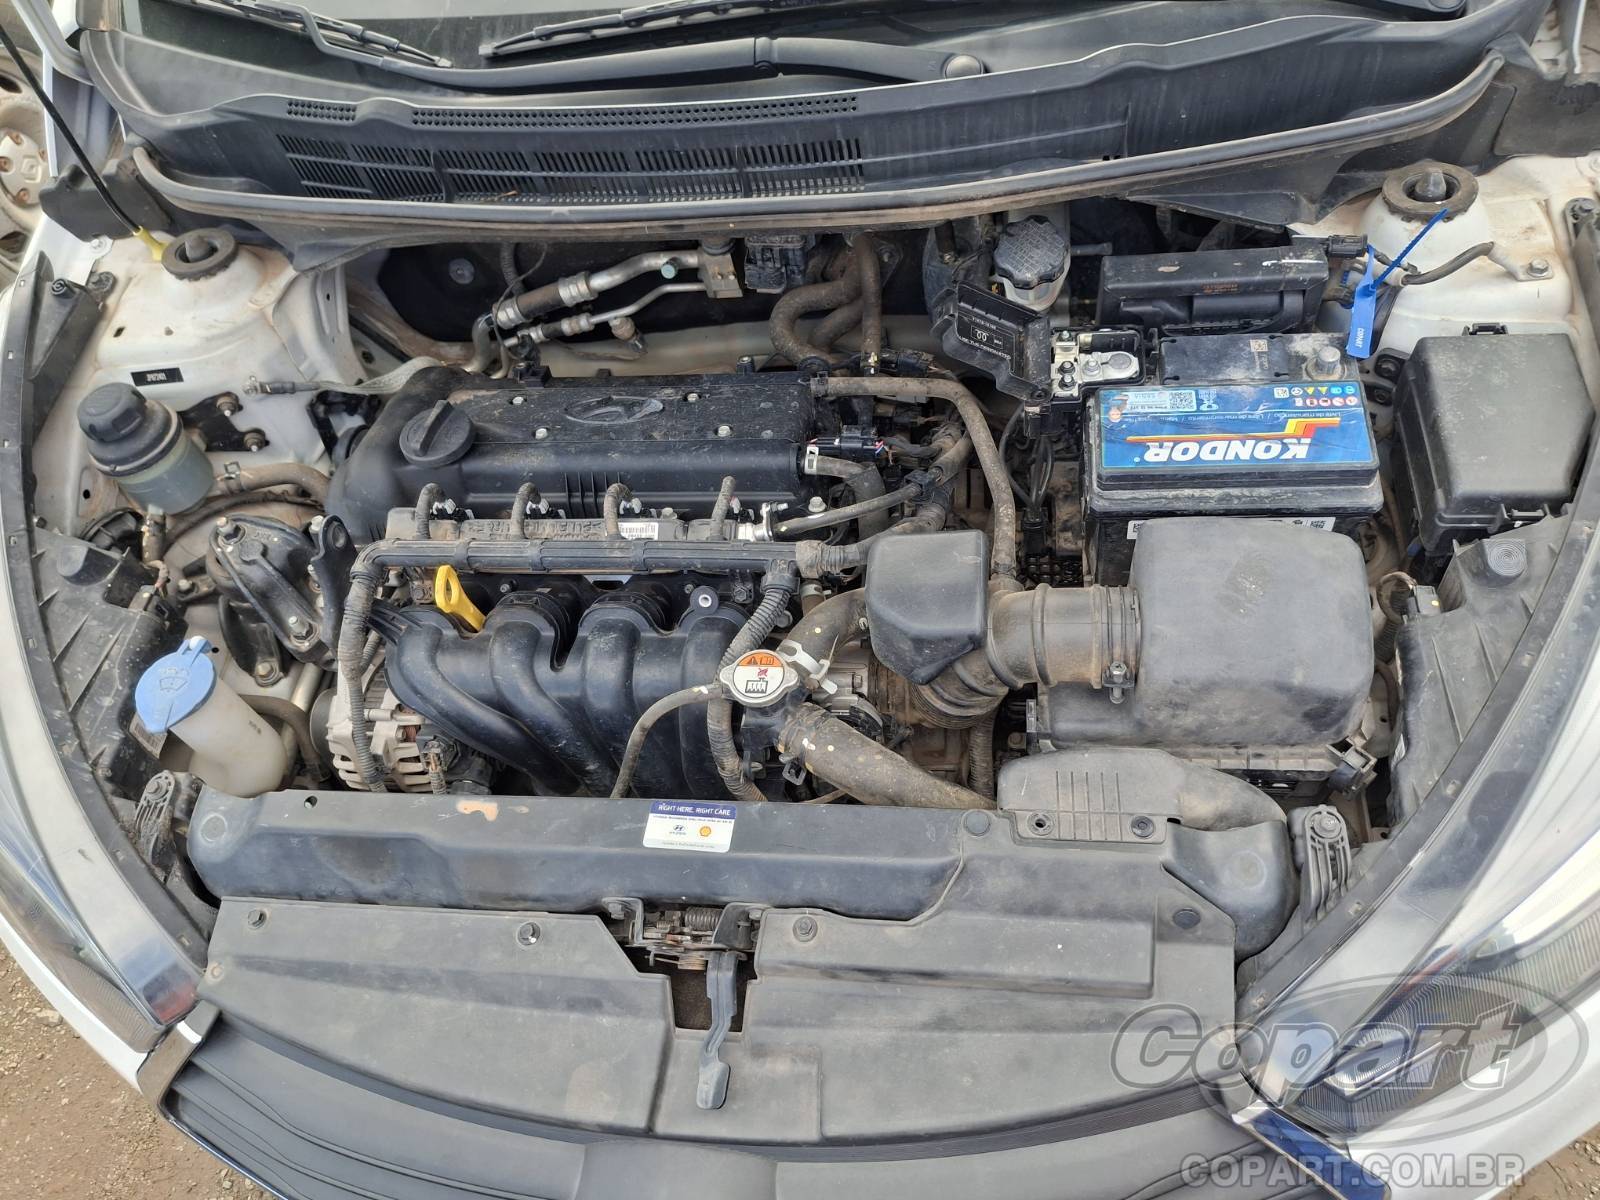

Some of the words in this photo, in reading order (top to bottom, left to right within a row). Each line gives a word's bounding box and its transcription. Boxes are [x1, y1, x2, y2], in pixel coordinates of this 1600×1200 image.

[1355, 327, 1365, 348] COPART
[1143, 437, 1312, 463] KONDOR
[658, 803, 676, 811] RIGHT
[714, 808, 731, 816] CARE
